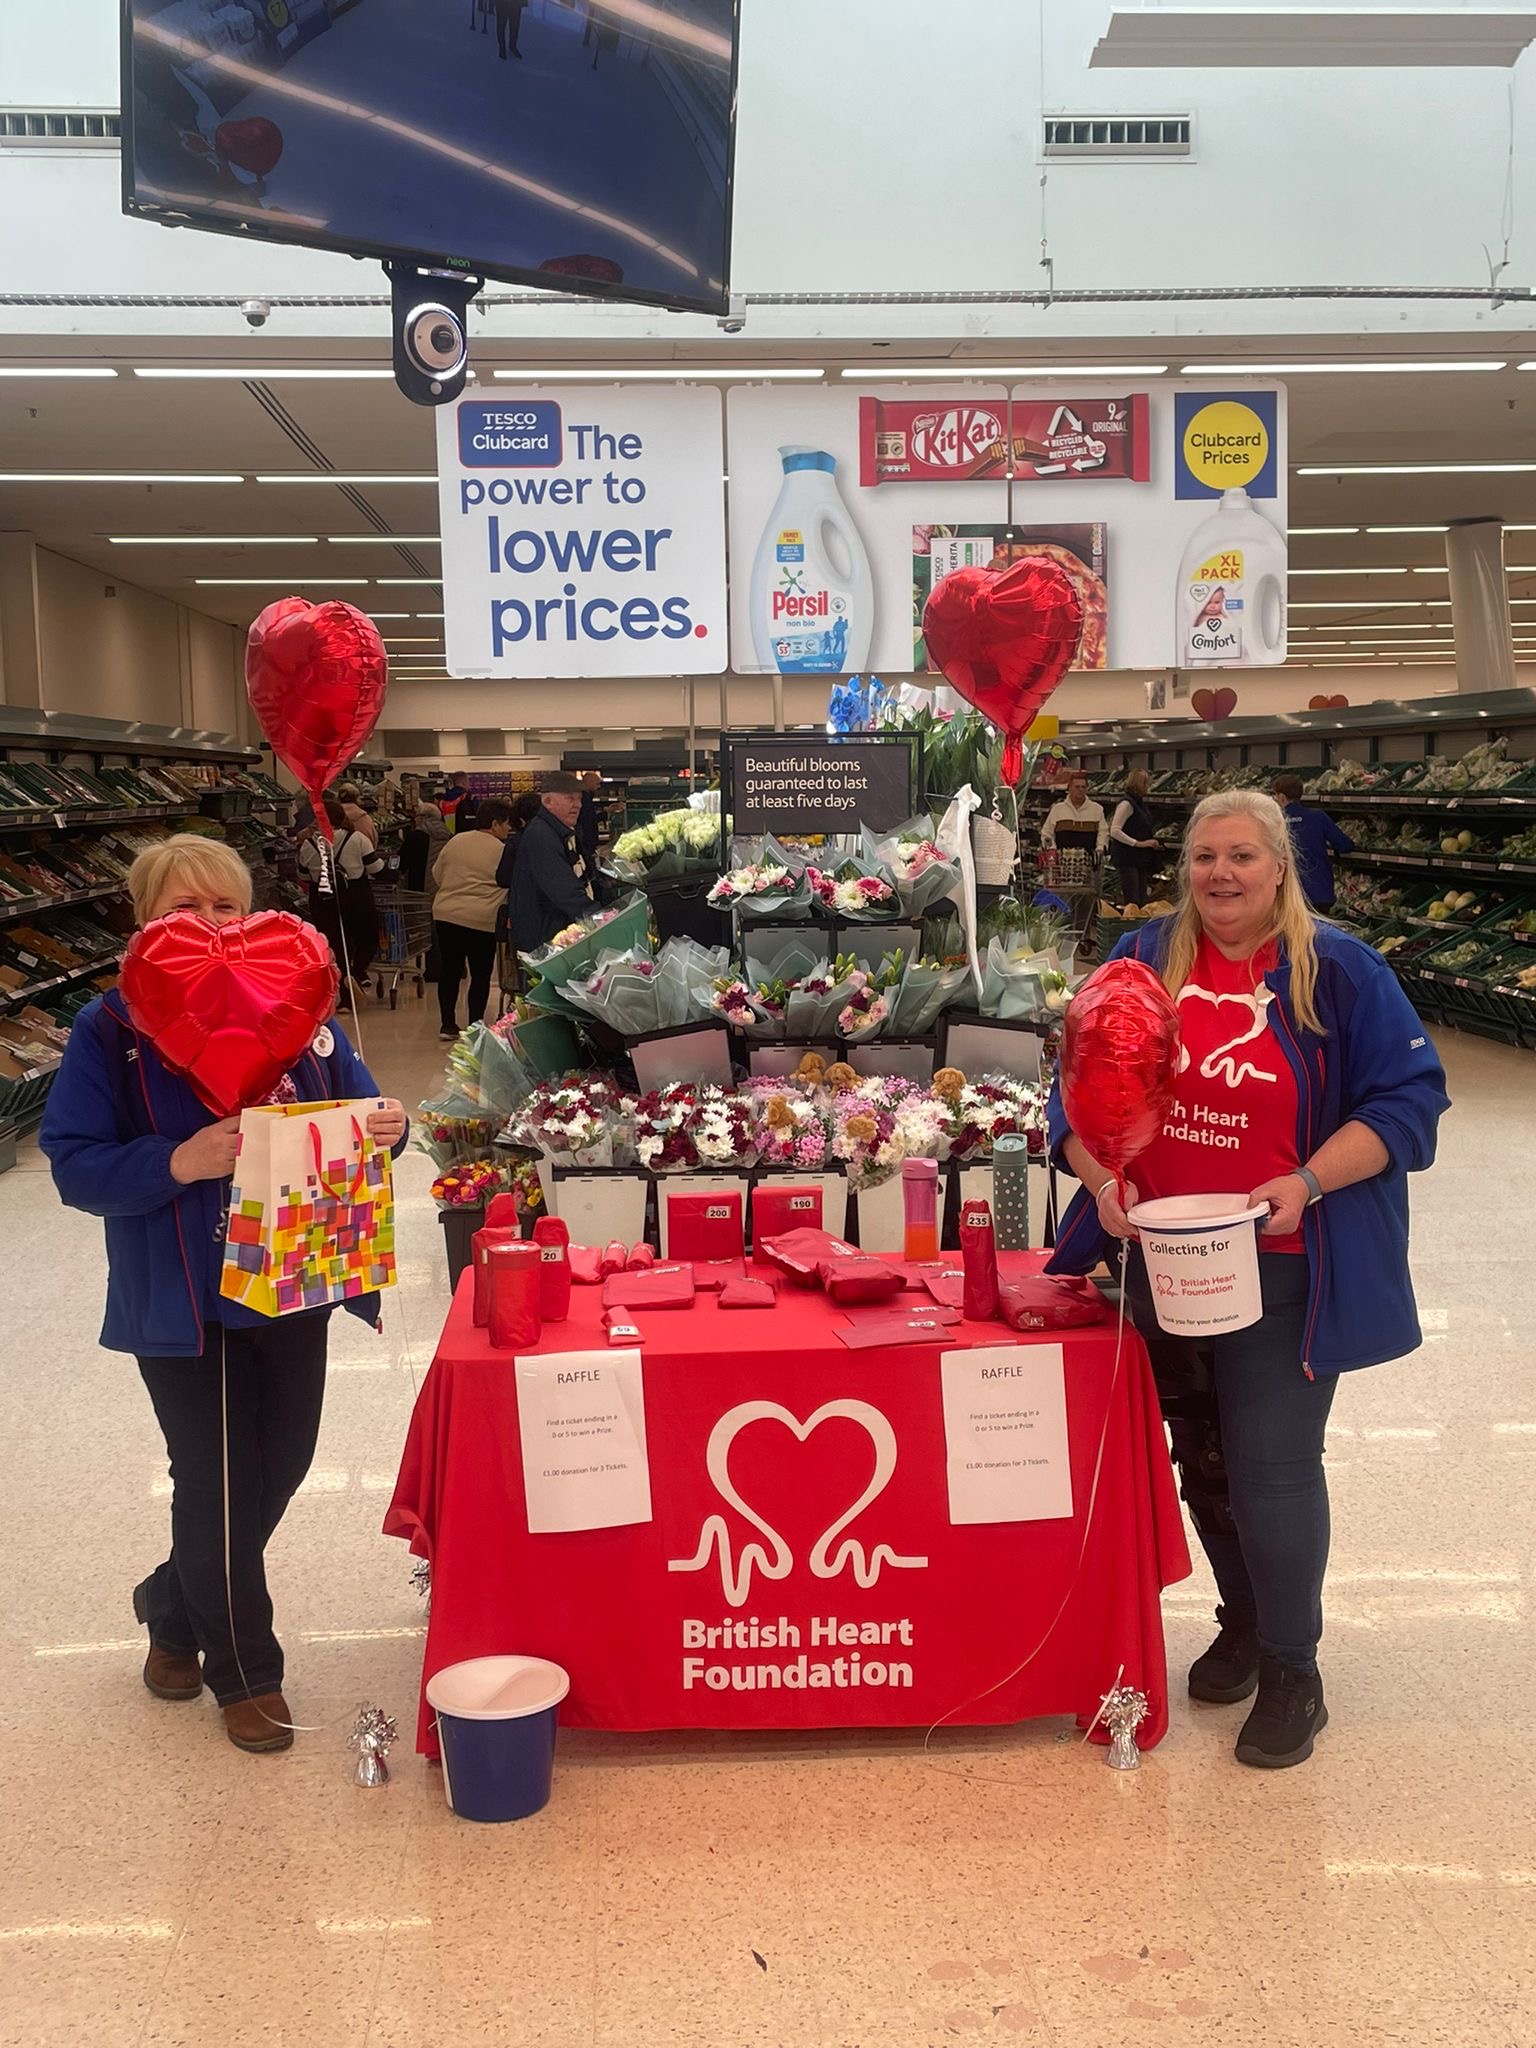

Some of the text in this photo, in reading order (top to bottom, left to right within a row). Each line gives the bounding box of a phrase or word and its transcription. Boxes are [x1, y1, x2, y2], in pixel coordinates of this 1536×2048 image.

[446, 257, 471, 267] neon
[1108, 402, 1117, 420] 9
[483, 413, 537, 425] TESCO
[1092, 422, 1128, 433] ORIGINAL
[473, 434, 549, 450] Clubcard
[568, 425, 643, 460] The
[924, 410, 995, 465] KitKat
[1051, 435, 1083, 448] RECYCLED
[1191, 433, 1261, 448] Clubcard
[1049, 447, 1088, 460] RECYCLABLE
[1203, 451, 1250, 465] Prices
[460, 471, 646, 514] power to
[488, 515, 673, 573] lower
[950, 542, 958, 570] HERITA
[1220, 555, 1240, 567] XL
[1200, 568, 1240, 579] PACK
[773, 591, 828, 620] Persil
[491, 583, 708, 657] prices.
[1191, 634, 1236, 650] Comfort
[779, 646, 788, 654] 53
[745, 758, 861, 772] Beautiful blooms
[745, 776, 868, 793] guaranteed to last
[745, 794, 856, 810] at least five days
[1193, 1104, 1249, 1129] Heart
[1163, 1123, 1240, 1150] ndation
[794, 1200, 811, 1208] 190
[710, 1209, 727, 1217] 200
[969, 1216, 987, 1225] 235
[1149, 1240, 1230, 1257] Collecting for
[543, 1252, 557, 1260] 20
[1180, 1274, 1236, 1287] British Heart
[1182, 1285, 1233, 1296] Foundation
[557, 1370, 601, 1384] RAFFLE
[981, 1366, 1024, 1379] RAFFLE
[565, 1417, 583, 1425] ticket
[560, 1467, 588, 1475] donation
[682, 1616, 914, 1649] British Heart
[682, 1652, 914, 1691] Foundation
